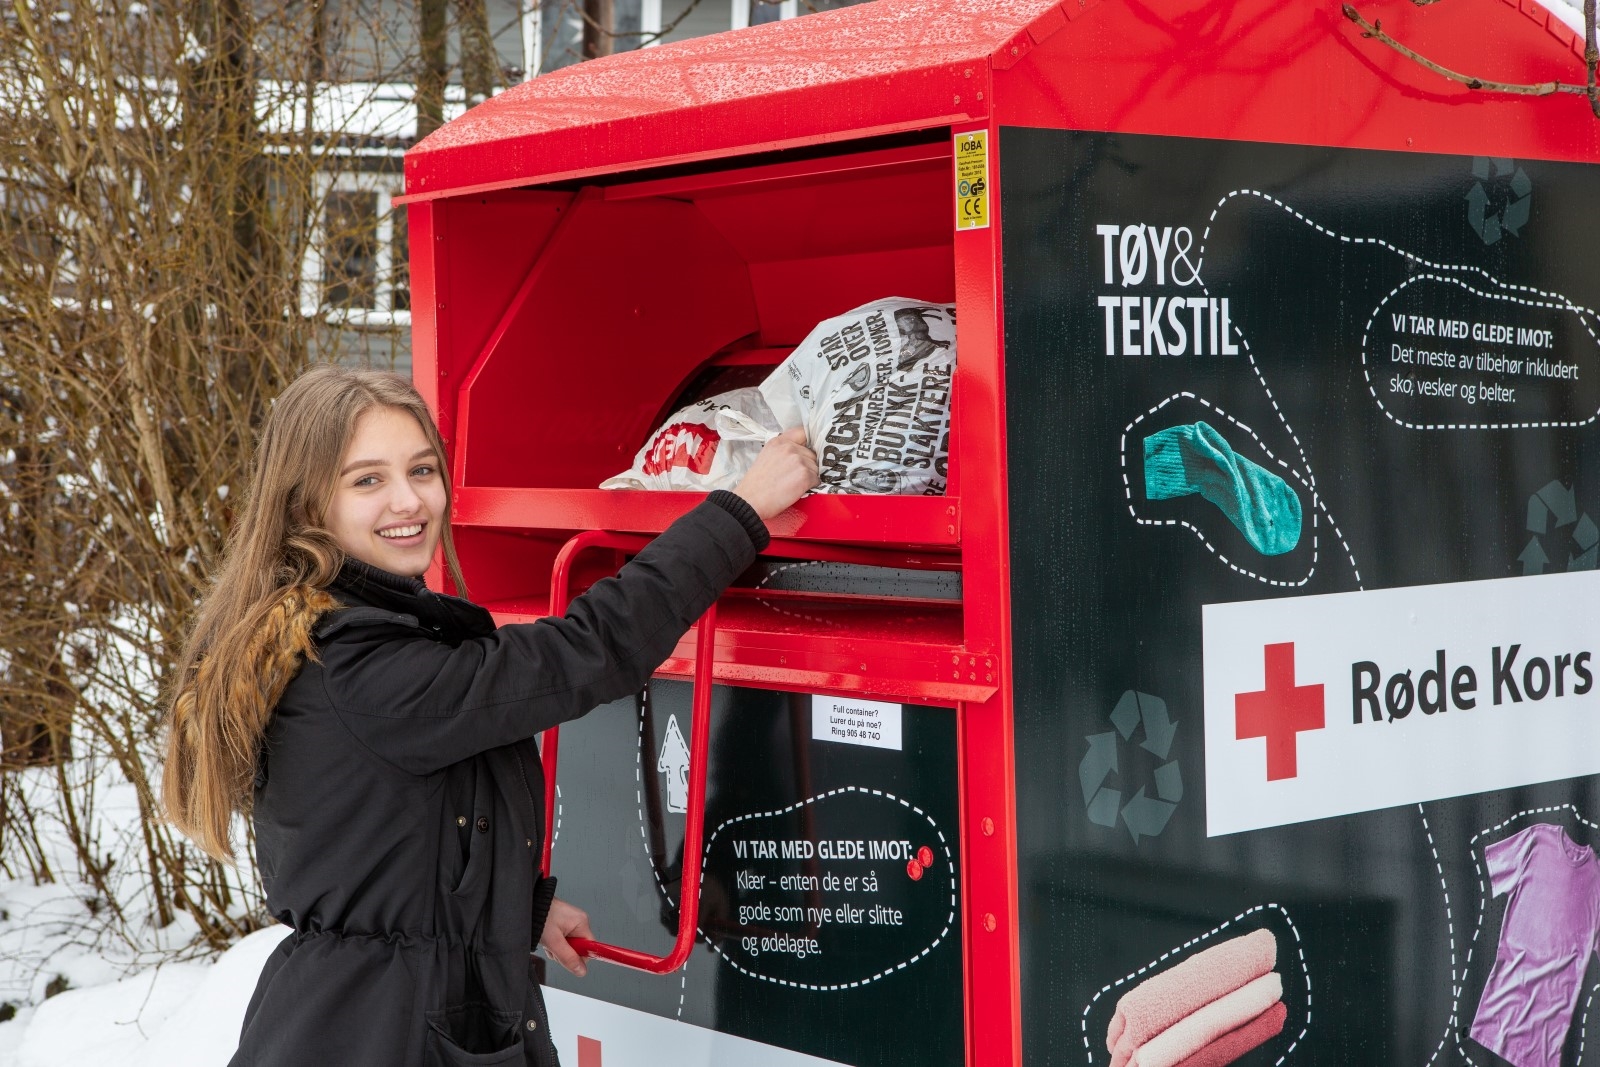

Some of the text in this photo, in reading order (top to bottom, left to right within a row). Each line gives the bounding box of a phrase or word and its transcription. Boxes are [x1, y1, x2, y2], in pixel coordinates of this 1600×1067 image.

[961, 140, 982, 152] JOBA
[965, 198, 981, 216] CE
[1098, 296, 1239, 356] TEKSTIL
[1392, 314, 1553, 348] VI TAR MED GLEDE IMOT:
[817, 332, 849, 371] STÅR
[1391, 344, 1579, 380] Det meste av tilbehør inkludert
[1390, 374, 1516, 404] sko, vesker og belter.
[872, 375, 919, 464] BUTIKK-
[903, 363, 951, 469] SLAKTERE
[1352, 644, 1593, 725] Røde Kors
[830, 716, 846, 725] Lurer
[848, 718, 856, 726] du
[857, 719, 865, 728] på
[833, 705, 879, 717] Full container?
[832, 727, 846, 737] Ring
[847, 729, 857, 737] 905
[859, 731, 867, 739] 48
[733, 841, 913, 860] VI TAR MED GLEDE IMOT:
[737, 870, 766, 890] Klær
[780, 874, 819, 891] enten
[823, 871, 840, 891] de
[844, 877, 858, 892] er
[862, 870, 878, 892] så
[739, 901, 903, 928] gode som nye eller slitte
[742, 933, 822, 958] og ødelagte.
